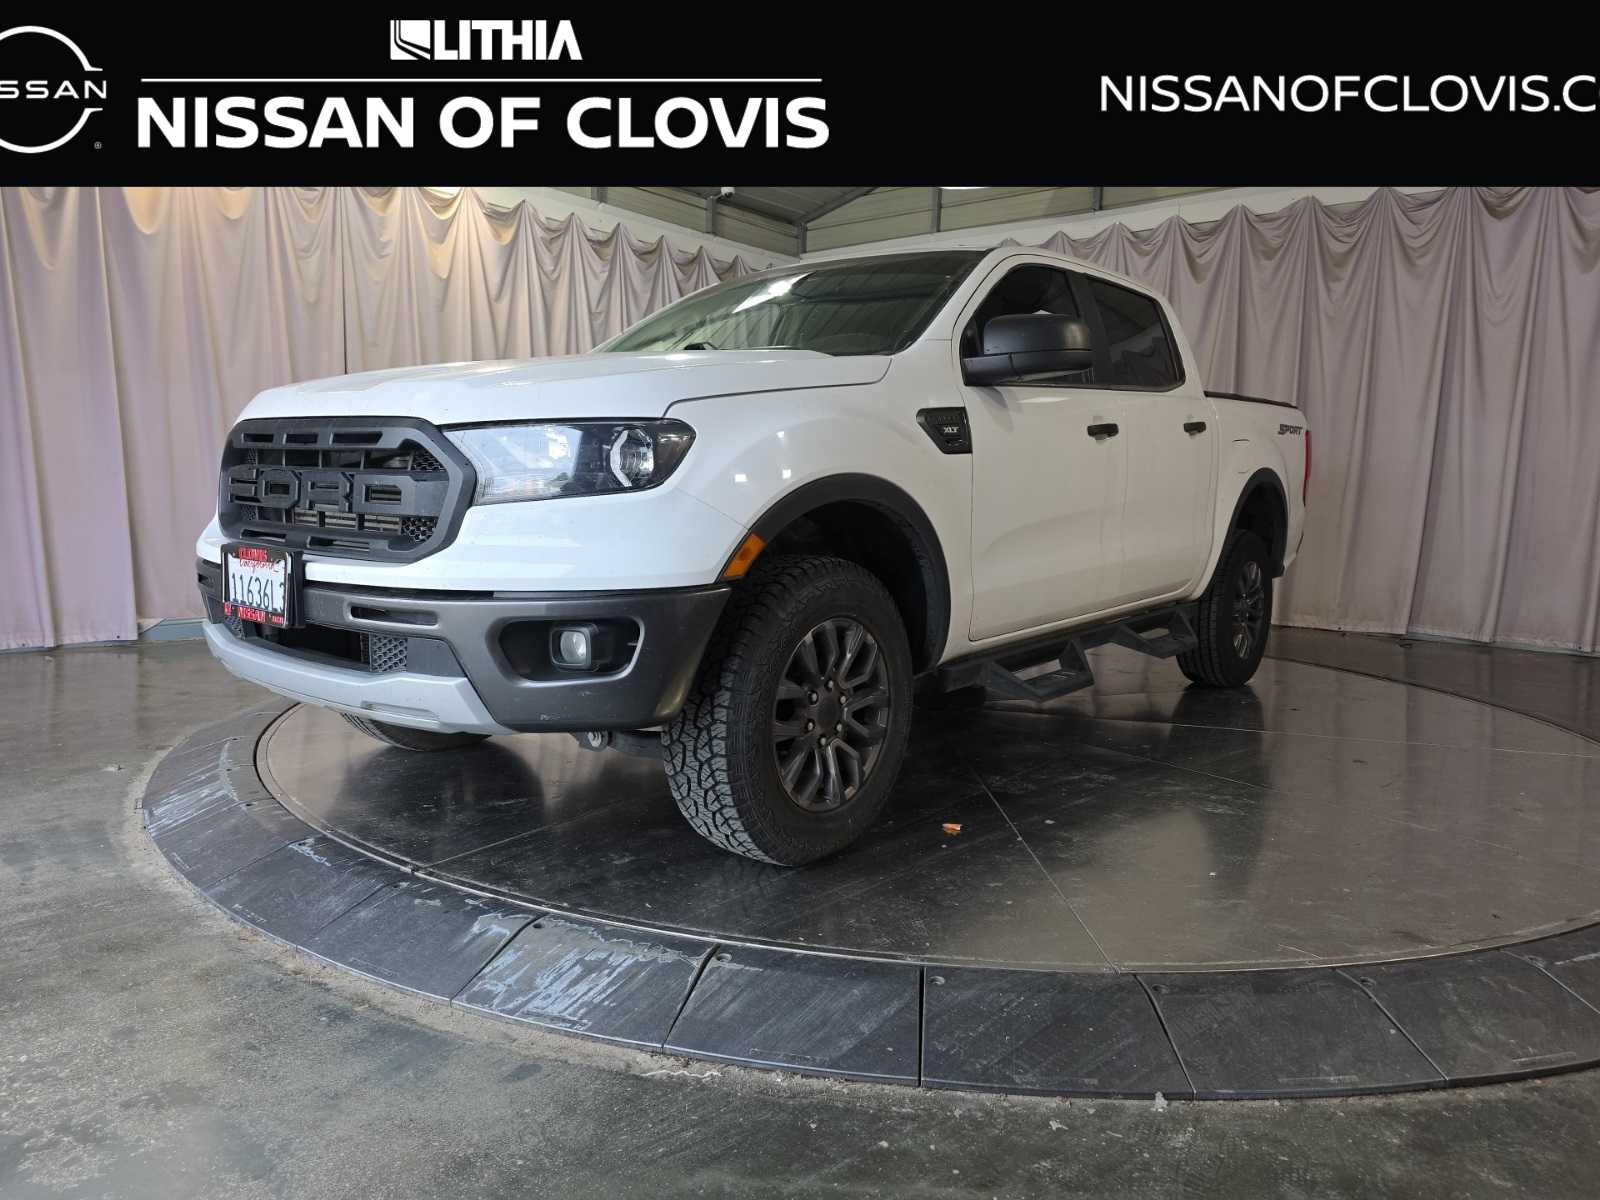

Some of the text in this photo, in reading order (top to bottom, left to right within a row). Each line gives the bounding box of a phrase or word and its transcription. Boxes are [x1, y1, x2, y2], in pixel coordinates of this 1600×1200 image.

[943, 426, 959, 434] XLT
[1278, 424, 1303, 435] SPORT
[228, 466, 413, 515] FORD
